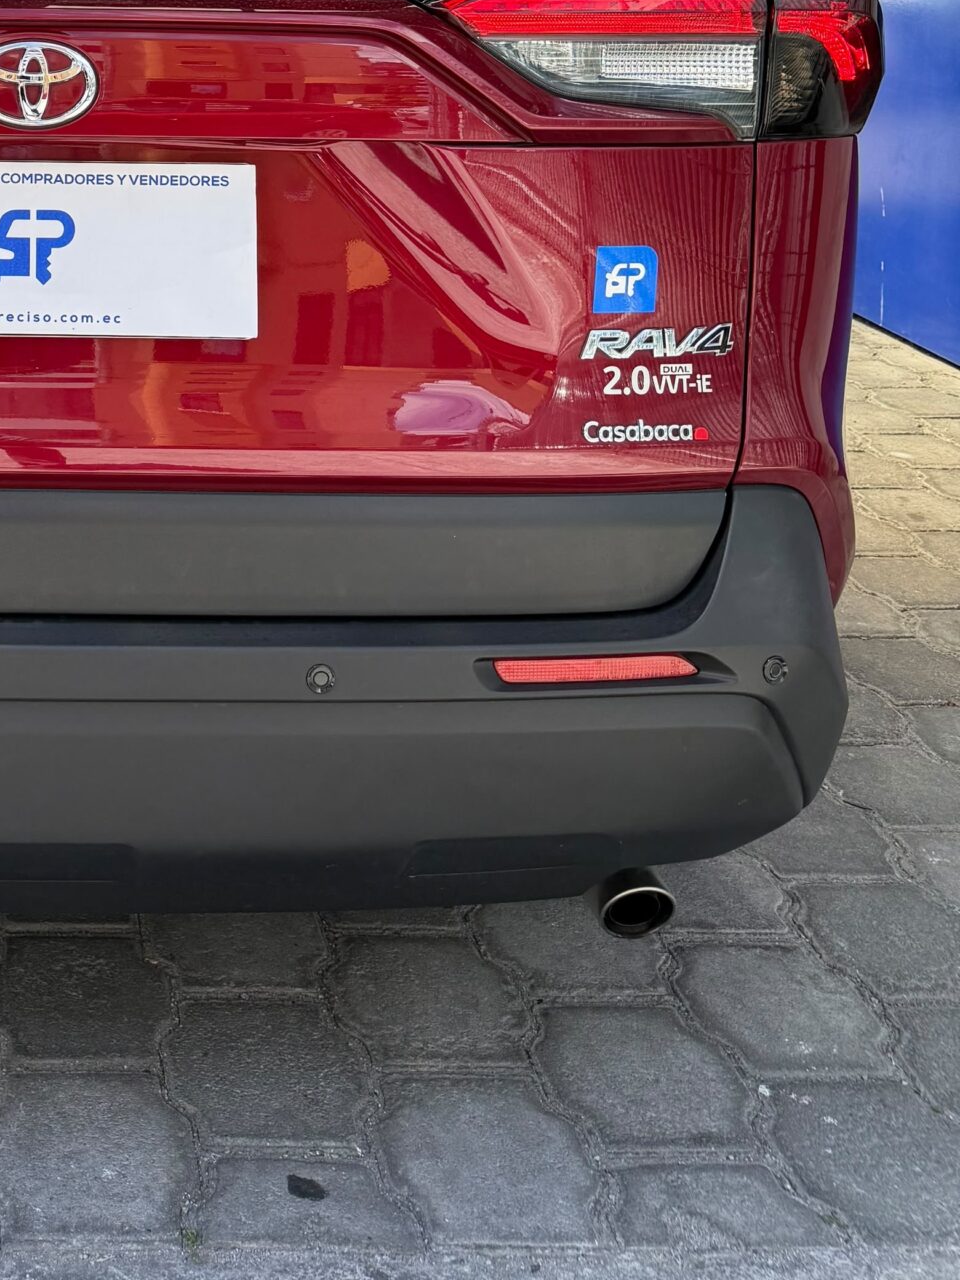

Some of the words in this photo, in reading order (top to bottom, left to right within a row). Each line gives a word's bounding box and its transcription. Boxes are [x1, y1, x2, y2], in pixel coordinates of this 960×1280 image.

[0, 172, 115, 186] COMPRADORES
[117, 174, 127, 185] Y
[128, 174, 230, 187] VENDEDORES
[580, 322, 734, 360] RAV4
[602, 365, 651, 396] 2.0
[662, 365, 691, 374] DUAL
[583, 419, 694, 443] Casabaca
